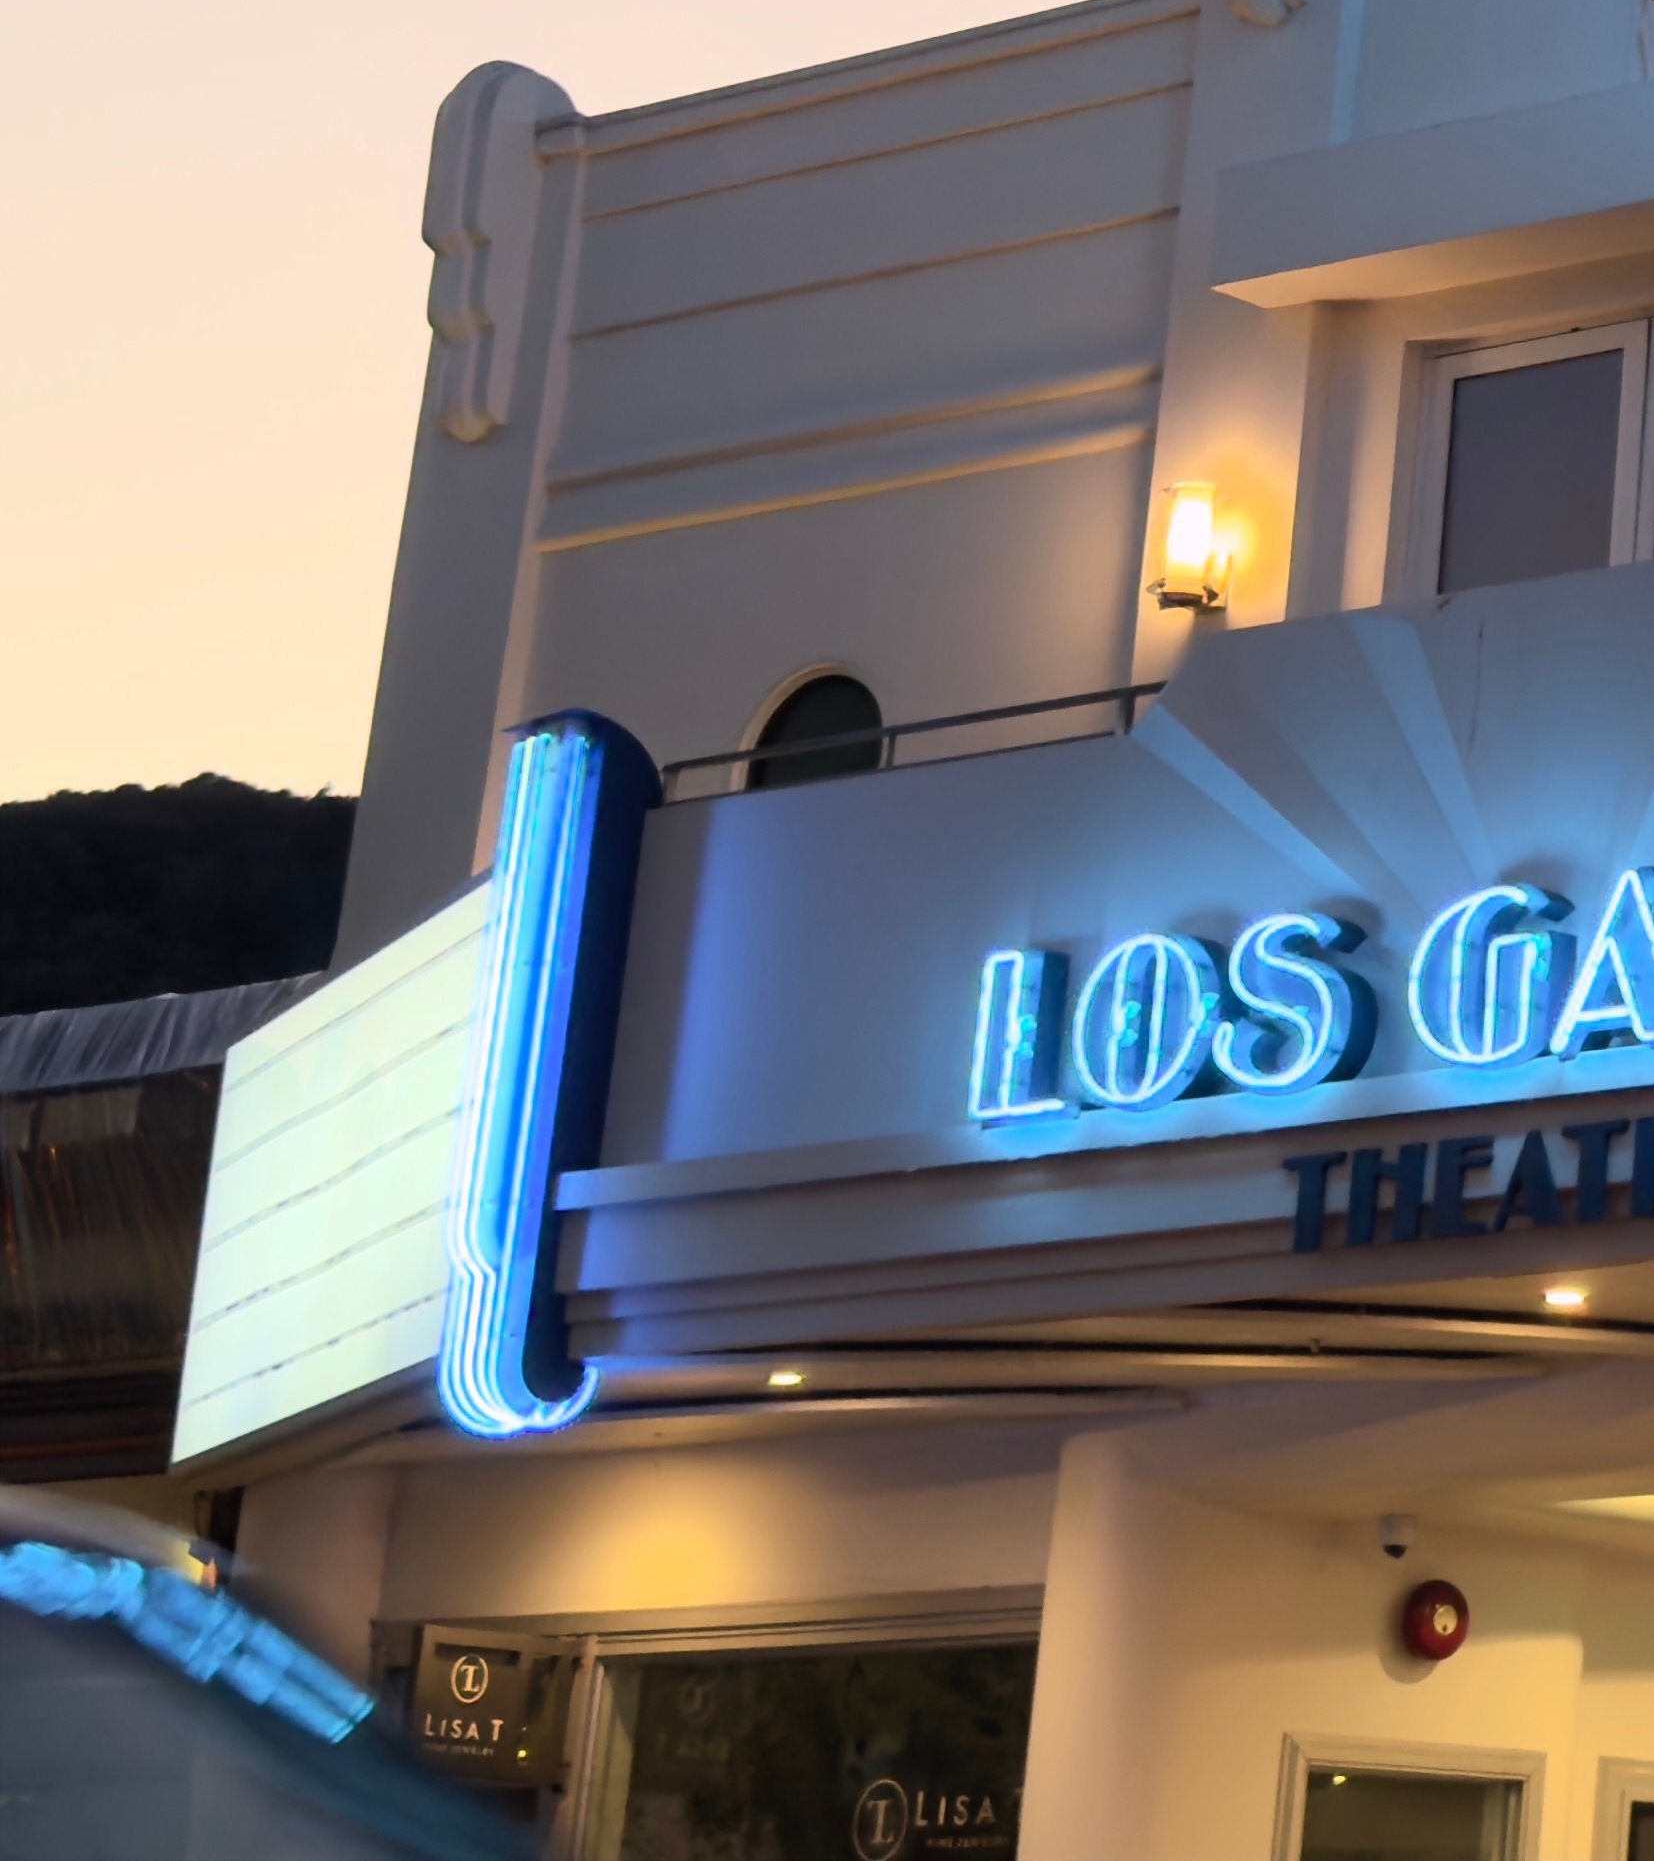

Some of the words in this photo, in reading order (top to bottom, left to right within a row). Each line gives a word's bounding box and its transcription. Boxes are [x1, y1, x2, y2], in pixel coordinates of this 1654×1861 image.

[967, 909, 1376, 1125] LOS
[425, 1712, 480, 1740] LISA
[491, 1718, 504, 1741] T
[915, 1790, 997, 1828] LISA
